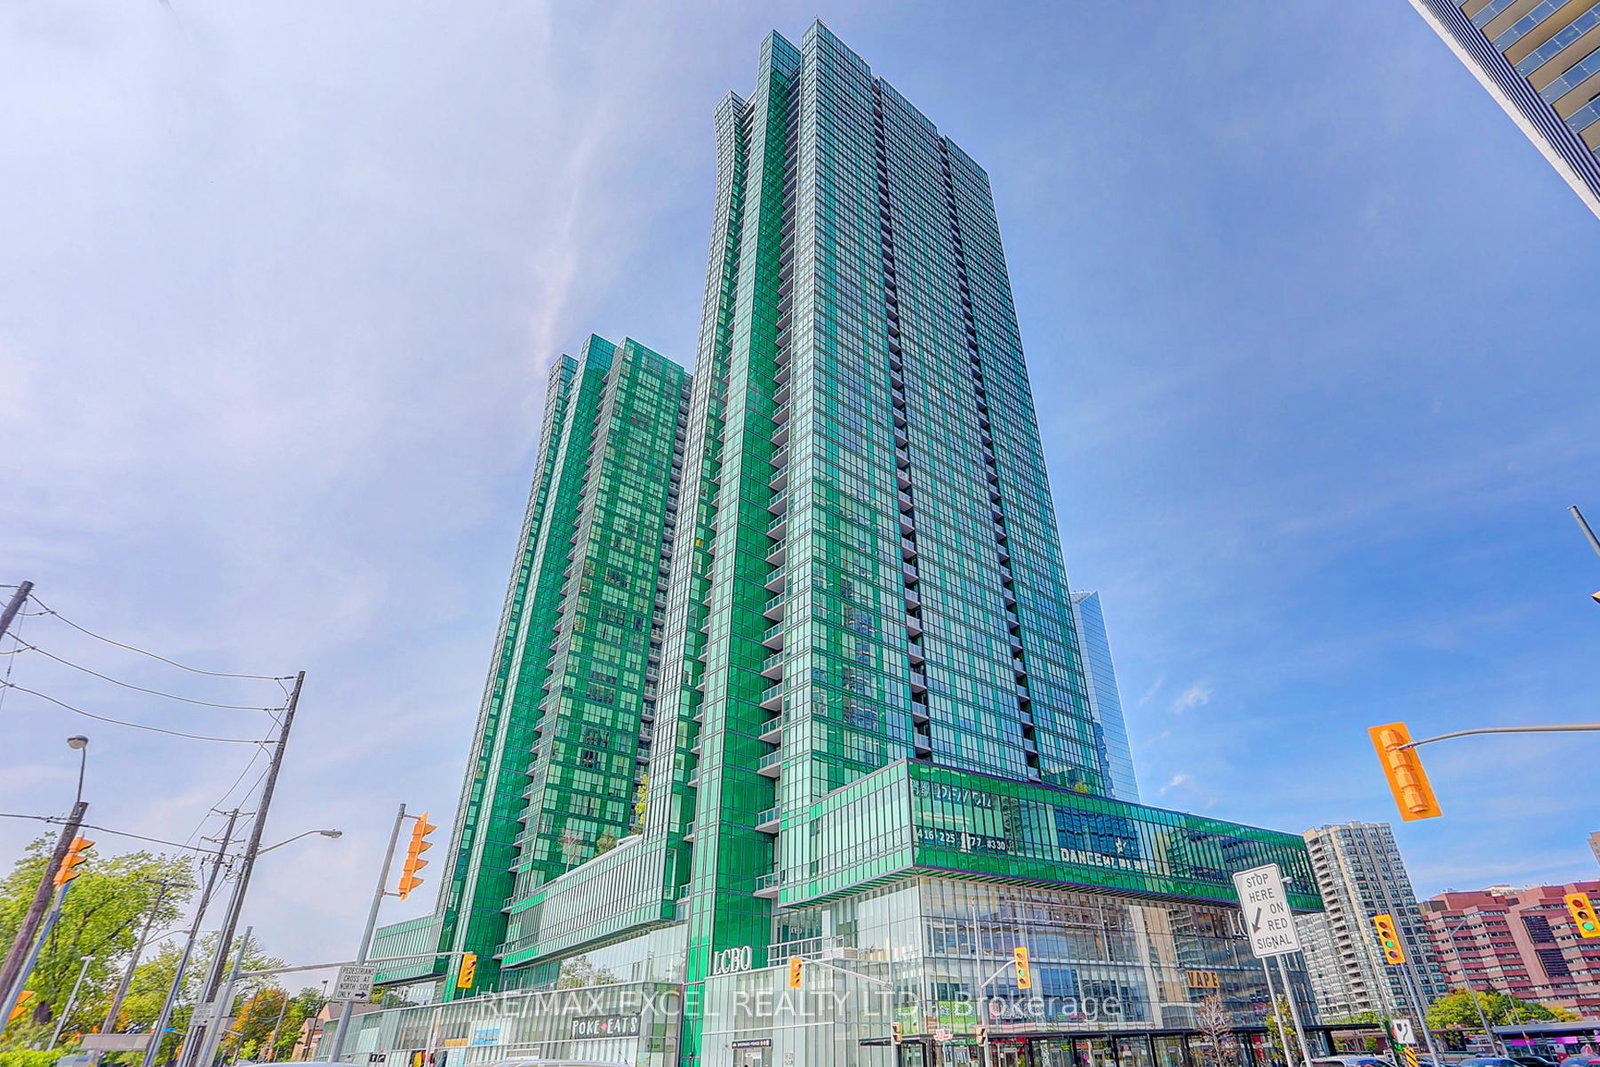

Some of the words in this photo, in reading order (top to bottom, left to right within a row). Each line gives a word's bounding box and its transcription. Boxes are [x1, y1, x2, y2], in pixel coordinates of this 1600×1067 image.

[1060, 848, 1104, 867] DANCE
[1246, 873, 1269, 888] STOP
[1248, 888, 1275, 903] HERE
[1269, 902, 1285, 914] ON
[1267, 917, 1288, 931] RED
[1256, 933, 1293, 949] SIGNAL
[712, 945, 752, 975] LCBO
[343, 975, 361, 983] CROSS
[363, 975, 371, 983] AT
[1187, 971, 1218, 987] VAPE
[358, 983, 371, 991] SIDE
[572, 1020, 601, 1038] POKE
[607, 1017, 637, 1034] EATS
